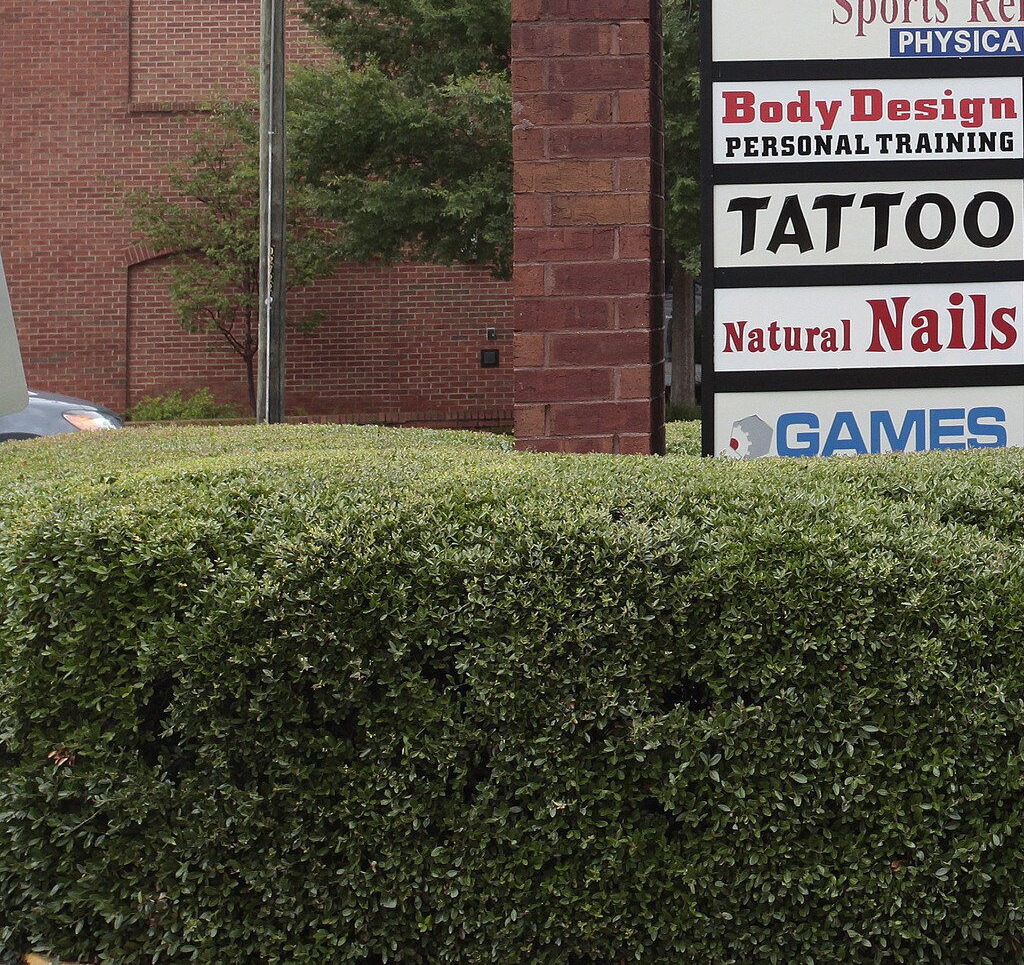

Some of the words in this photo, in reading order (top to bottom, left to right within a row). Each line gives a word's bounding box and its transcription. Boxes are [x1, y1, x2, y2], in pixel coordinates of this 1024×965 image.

[722, 90, 843, 131] Body
[850, 88, 1018, 129] Design
[725, 134, 871, 158] PERSONAL
[875, 131, 1015, 156] TRAINING
[727, 191, 1015, 256] TATTOO
[723, 320, 852, 354] Natural
[865, 292, 1018, 354] Nails
[776, 407, 1008, 457] GAMES
